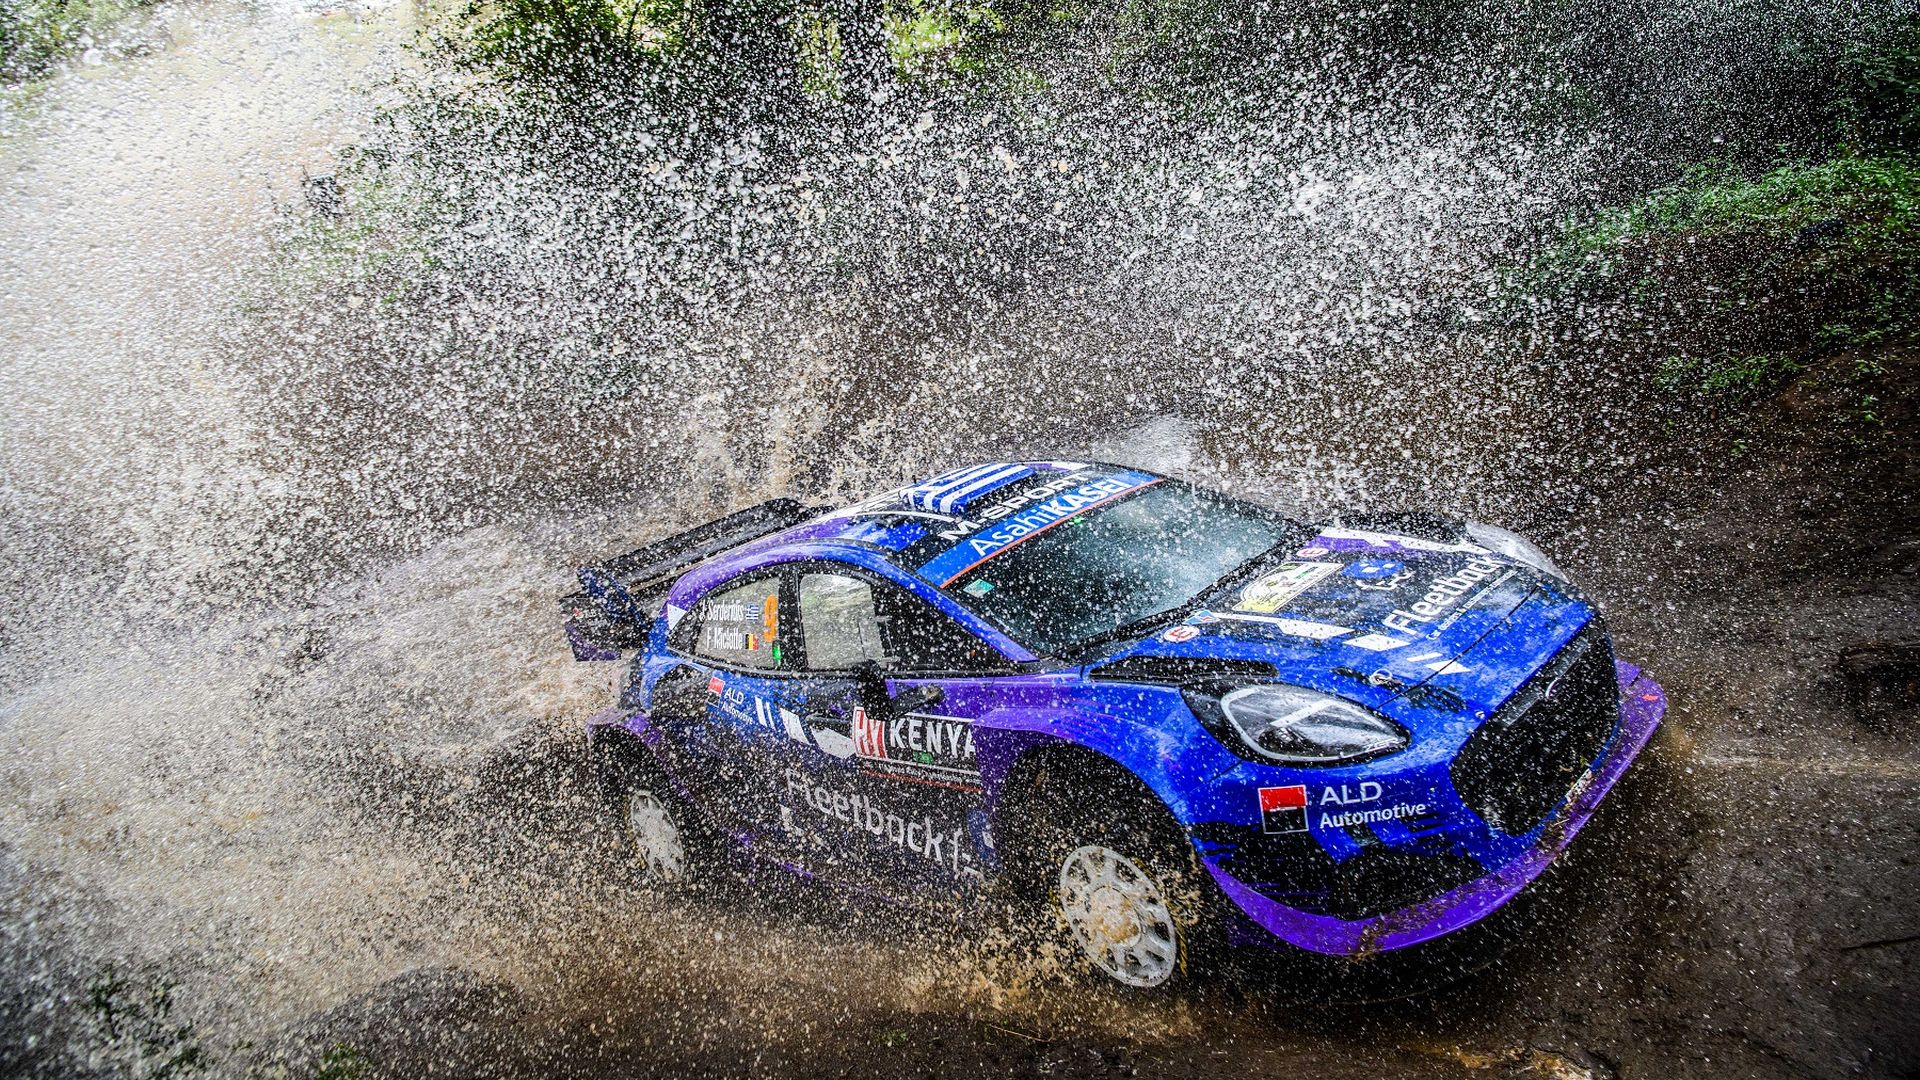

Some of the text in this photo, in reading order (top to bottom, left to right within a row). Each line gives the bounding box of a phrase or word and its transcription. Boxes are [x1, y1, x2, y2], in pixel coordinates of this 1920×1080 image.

[938, 473, 1089, 541] M-SPORT
[764, 594, 778, 642] 9
[1382, 556, 1508, 638] Fleetback
[724, 687, 744, 704] ALD
[890, 717, 977, 760] KENYA
[1319, 781, 1382, 806] ALD
[1319, 802, 1427, 830] Automotive
[785, 768, 943, 866] Fleetback
